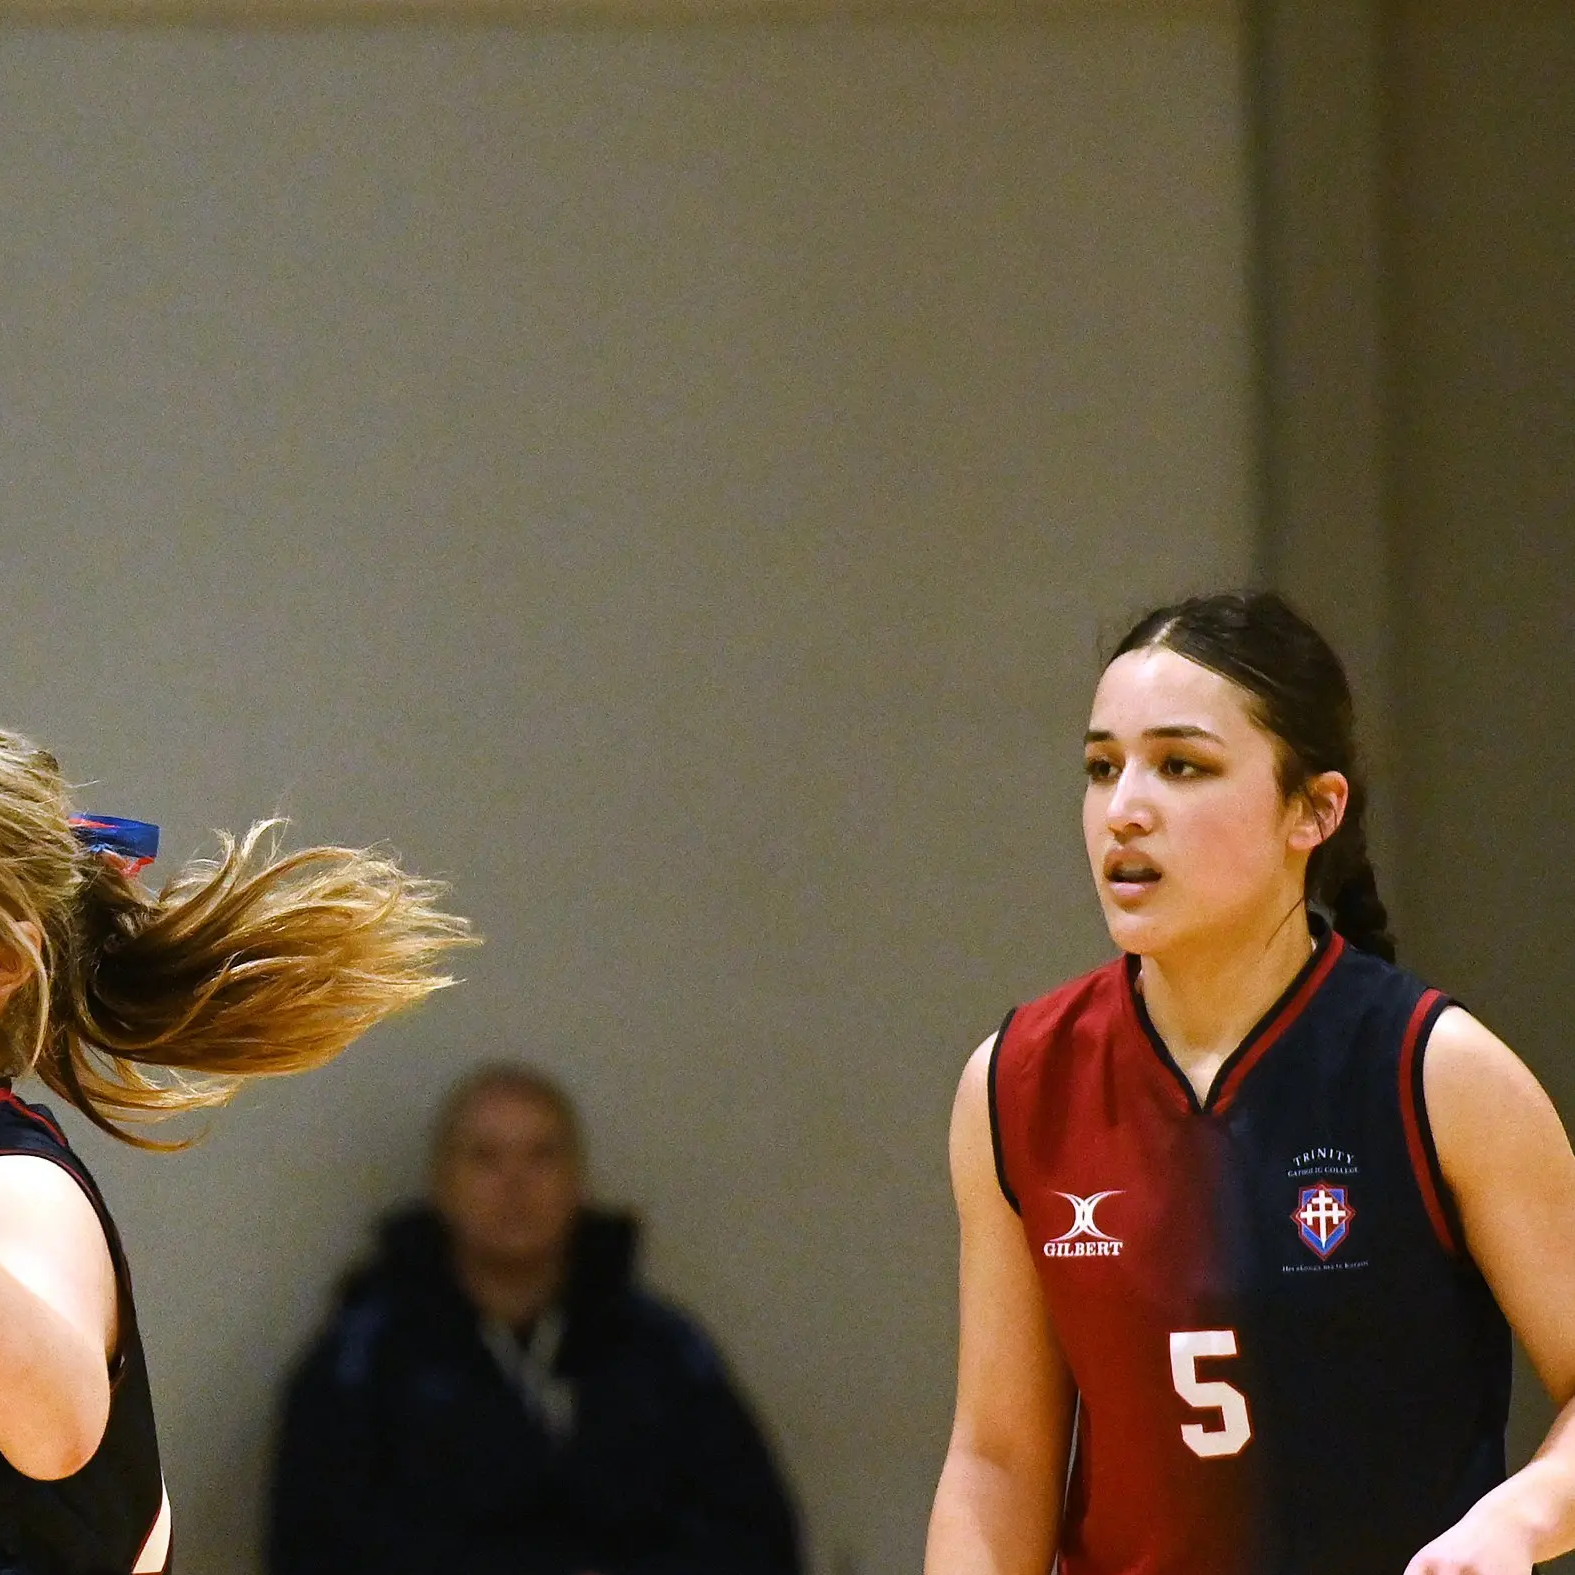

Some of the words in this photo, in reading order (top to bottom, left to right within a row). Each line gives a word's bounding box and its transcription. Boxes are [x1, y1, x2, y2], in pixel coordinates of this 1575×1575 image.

[1292, 1147, 1355, 1167] TRINITY
[1043, 1241, 1124, 1257] GILBERT
[1169, 1330, 1252, 1458] 5
